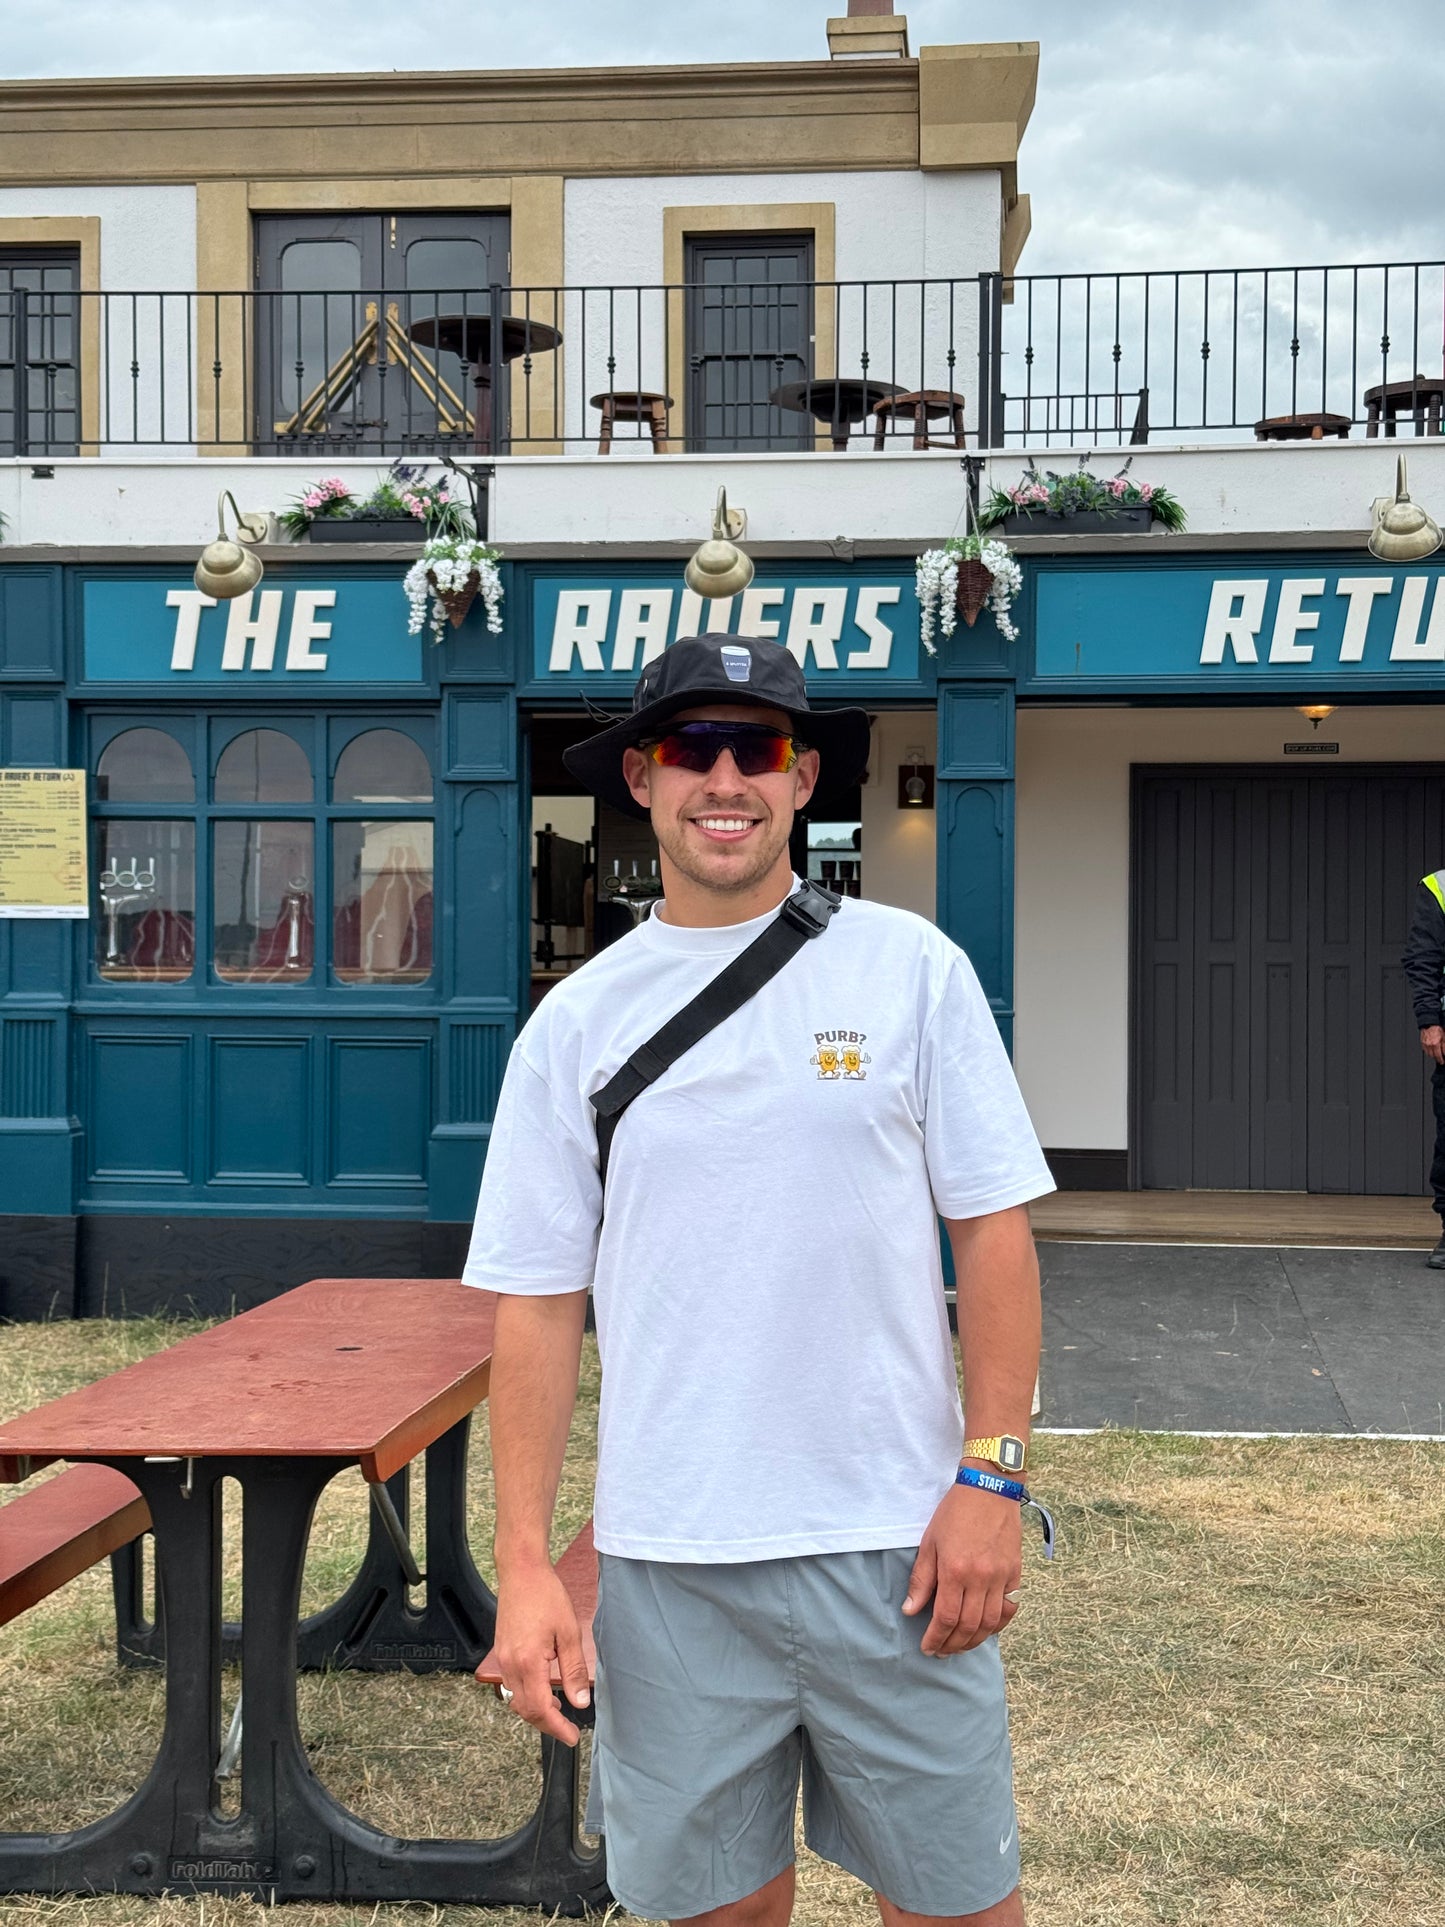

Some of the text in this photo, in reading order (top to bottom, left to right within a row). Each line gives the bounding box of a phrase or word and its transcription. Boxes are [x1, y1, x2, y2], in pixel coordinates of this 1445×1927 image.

[165, 589, 337, 671] THE
[814, 1030, 867, 1045] PURB?
[978, 1474, 1006, 1492] STAFF
